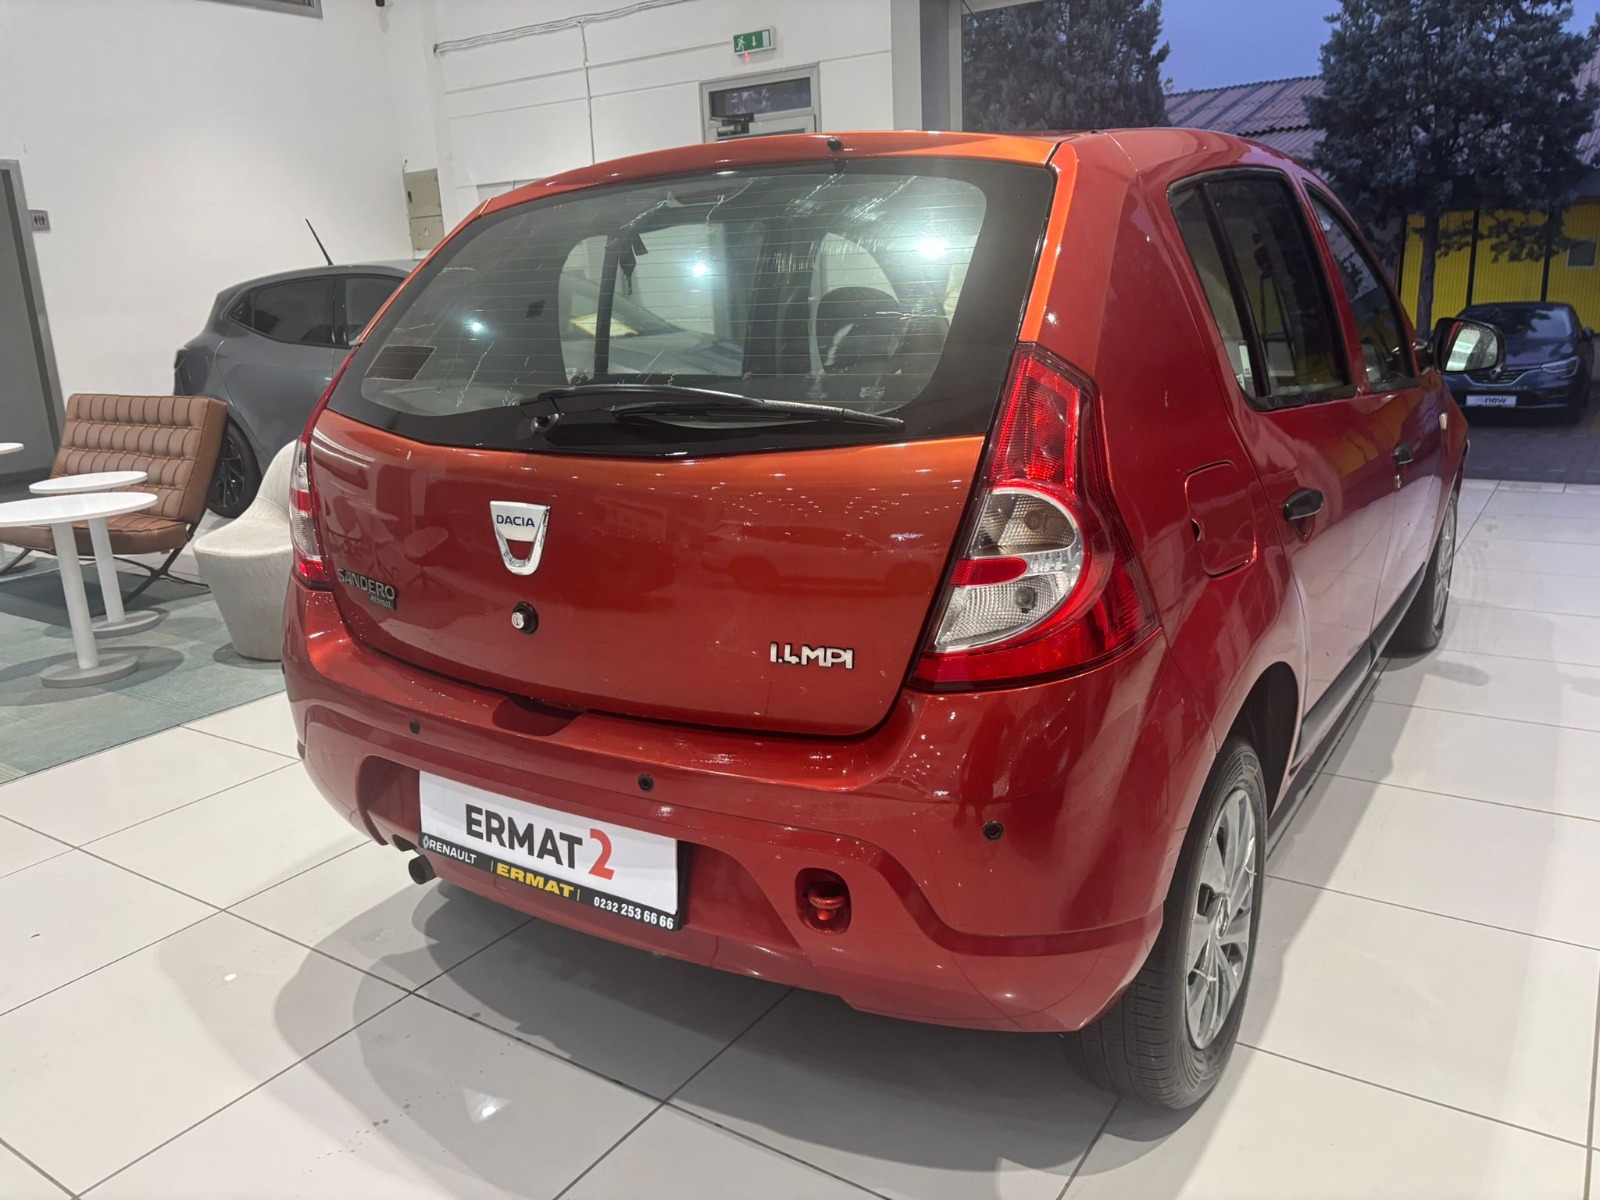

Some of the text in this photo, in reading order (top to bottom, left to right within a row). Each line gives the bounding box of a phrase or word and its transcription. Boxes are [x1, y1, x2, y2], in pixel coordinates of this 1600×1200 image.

[497, 514, 535, 528] DACIA
[337, 568, 396, 600] SANDERO
[465, 803, 615, 880] ERMAT 2
[429, 839, 674, 930] RENAULT ERMAT 0232 253 66 66
